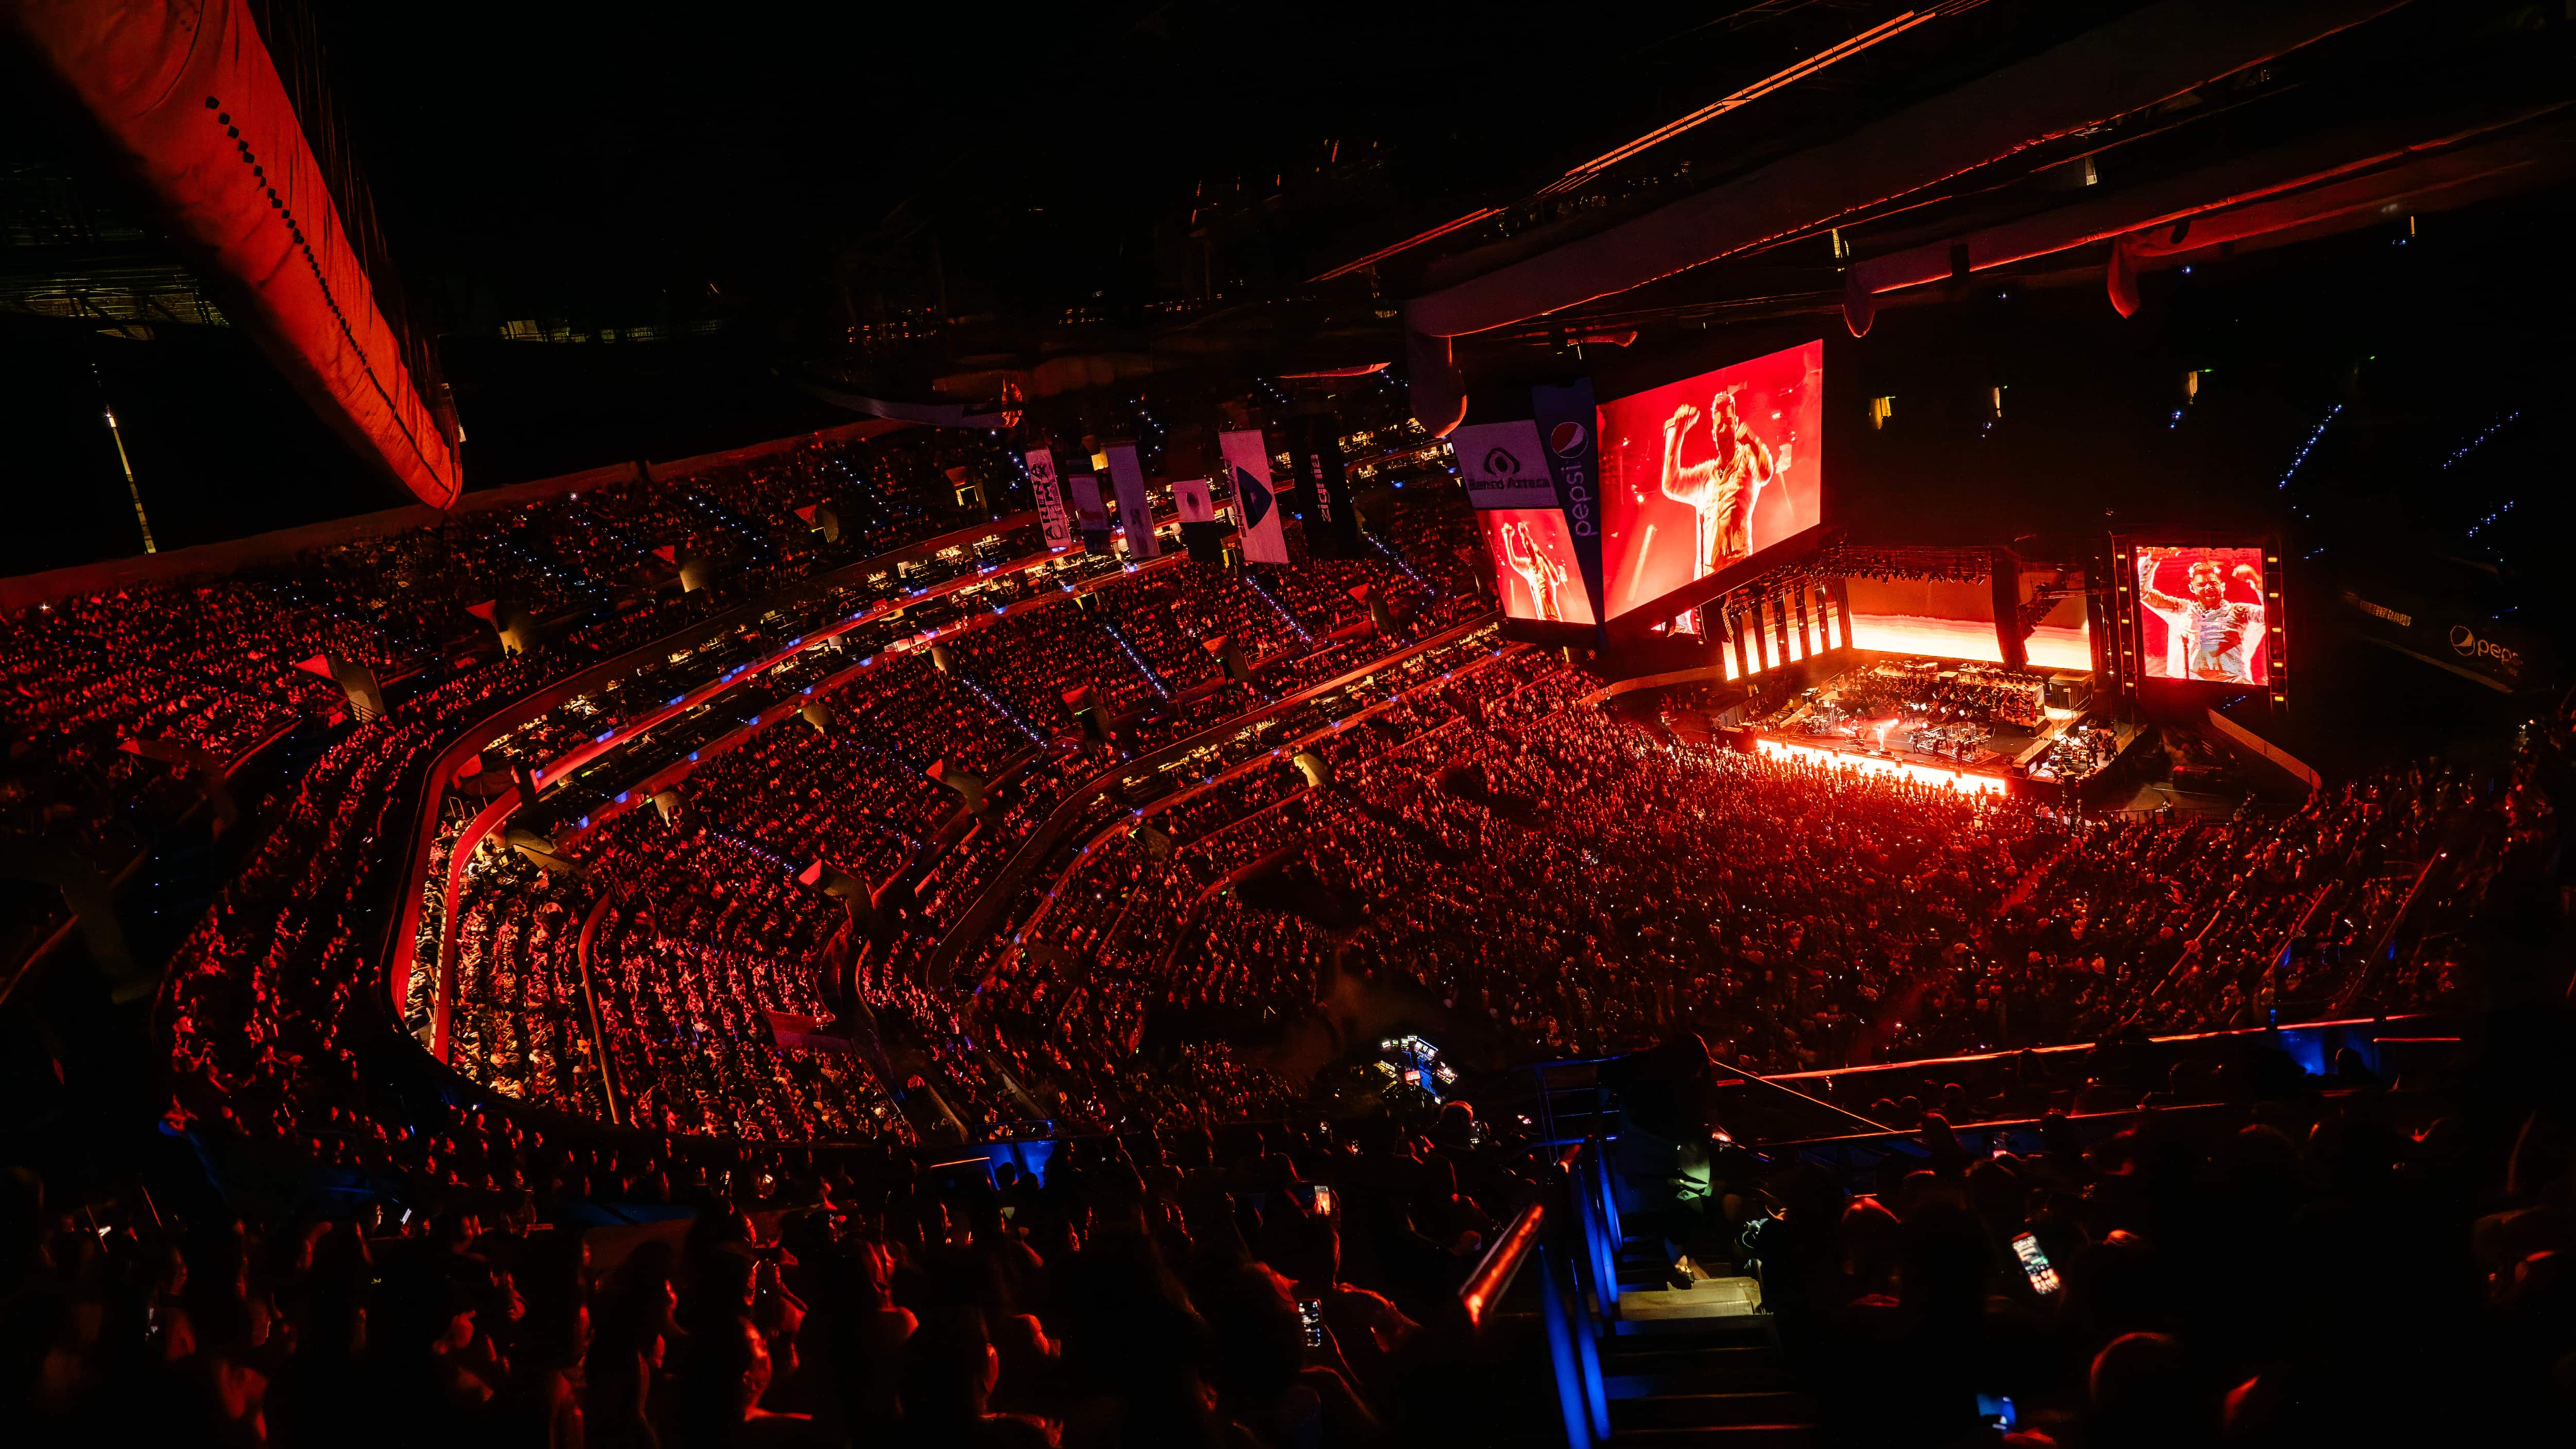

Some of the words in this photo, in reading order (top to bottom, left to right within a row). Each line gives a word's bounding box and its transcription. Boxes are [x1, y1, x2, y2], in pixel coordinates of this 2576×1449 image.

[1031, 464, 1052, 539] ARENA
[1561, 464, 1599, 536] pepsi
[2477, 639, 2520, 666] pep
